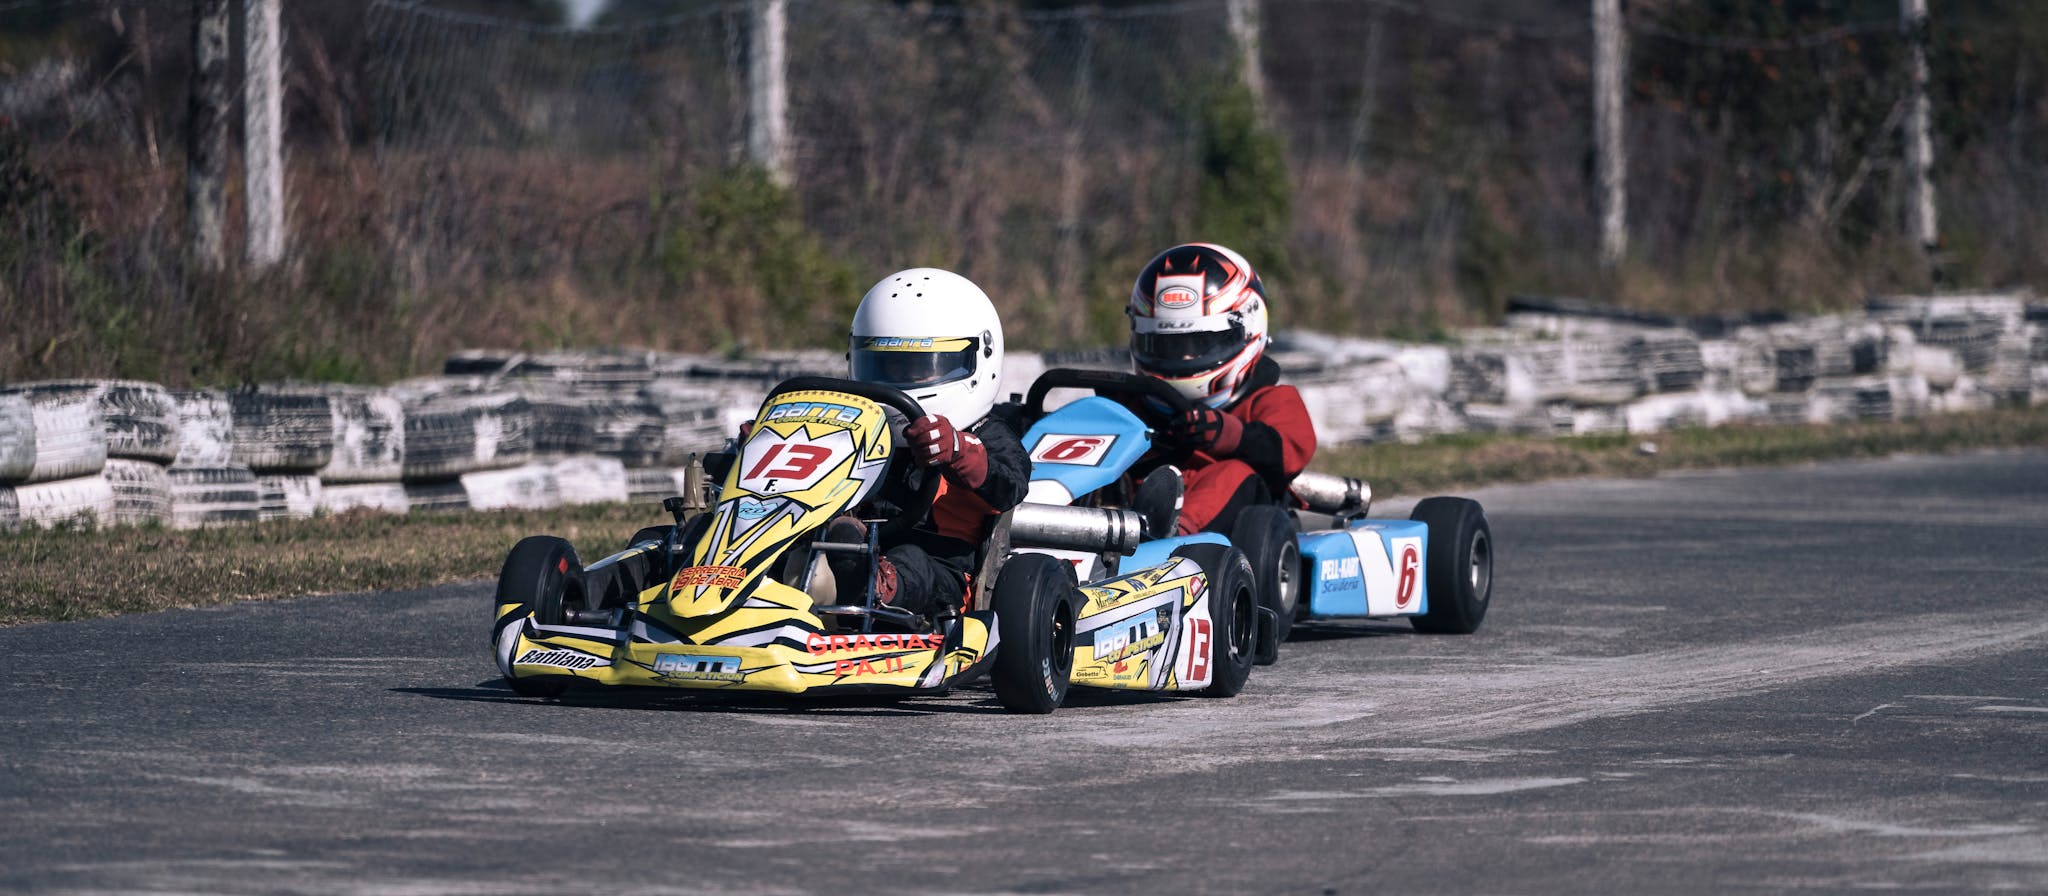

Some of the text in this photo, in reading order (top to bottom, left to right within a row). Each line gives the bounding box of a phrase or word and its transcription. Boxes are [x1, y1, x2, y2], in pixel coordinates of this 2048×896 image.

[1163, 293, 1192, 303] BELL
[743, 443, 833, 480] 13
[1039, 438, 1104, 462] 6
[689, 575, 706, 586] DE
[707, 575, 742, 590] ABRIL
[1396, 546, 1418, 608] 6
[806, 632, 945, 657] GRACIAS
[1186, 618, 1211, 681] 13
[518, 651, 596, 669] Battilana
[835, 659, 877, 677] PA
